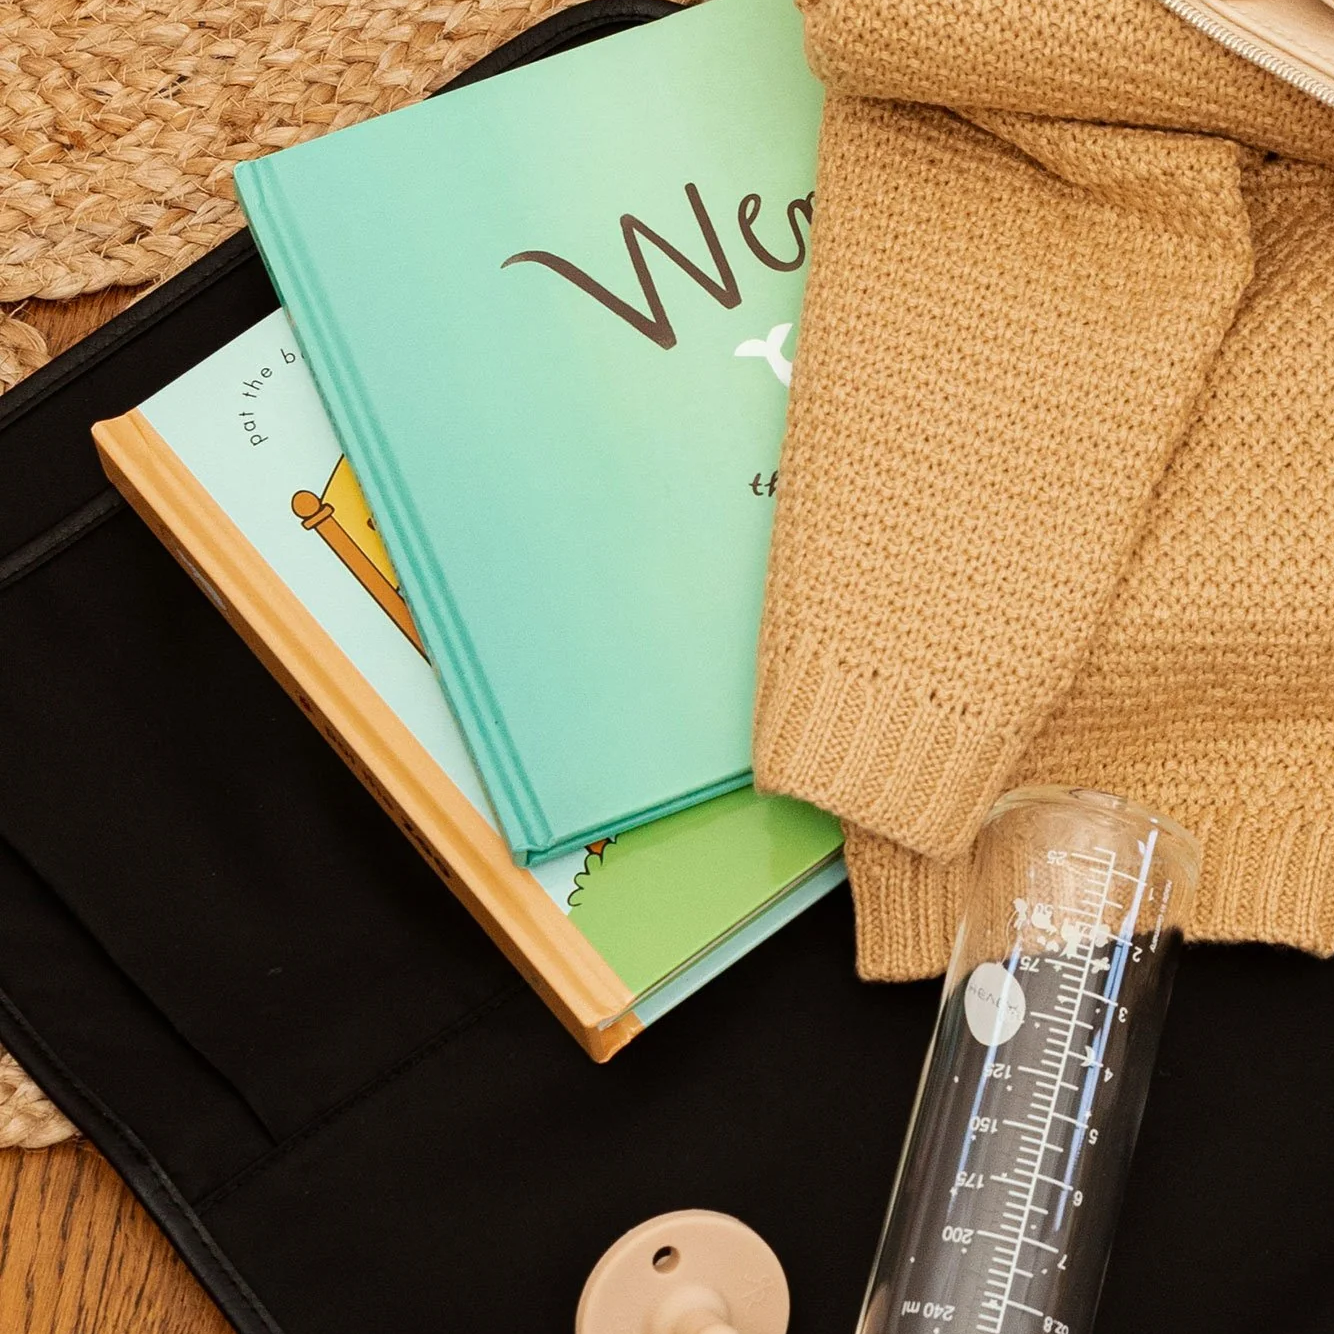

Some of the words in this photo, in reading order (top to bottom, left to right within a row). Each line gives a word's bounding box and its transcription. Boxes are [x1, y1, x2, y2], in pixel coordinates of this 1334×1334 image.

[280, 348, 305, 364] b
[242, 367, 273, 398] the
[238, 412, 269, 446] pat
[1046, 850, 1067, 866] 25
[1132, 945, 1143, 963] 2
[1019, 955, 1041, 973] 75
[1117, 1006, 1129, 1023] 3
[985, 1063, 1012, 1080] 125
[1103, 1067, 1114, 1083] 4
[969, 1115, 998, 1134] 150
[1088, 1128, 1099, 1145] 5
[956, 1170, 985, 1189] 175
[1072, 1190, 1083, 1207] 6
[942, 1225, 975, 1244] 200
[1057, 1254, 1068, 1271] 7
[901, 1300, 921, 1316] ml
[923, 1301, 956, 1322] 240
